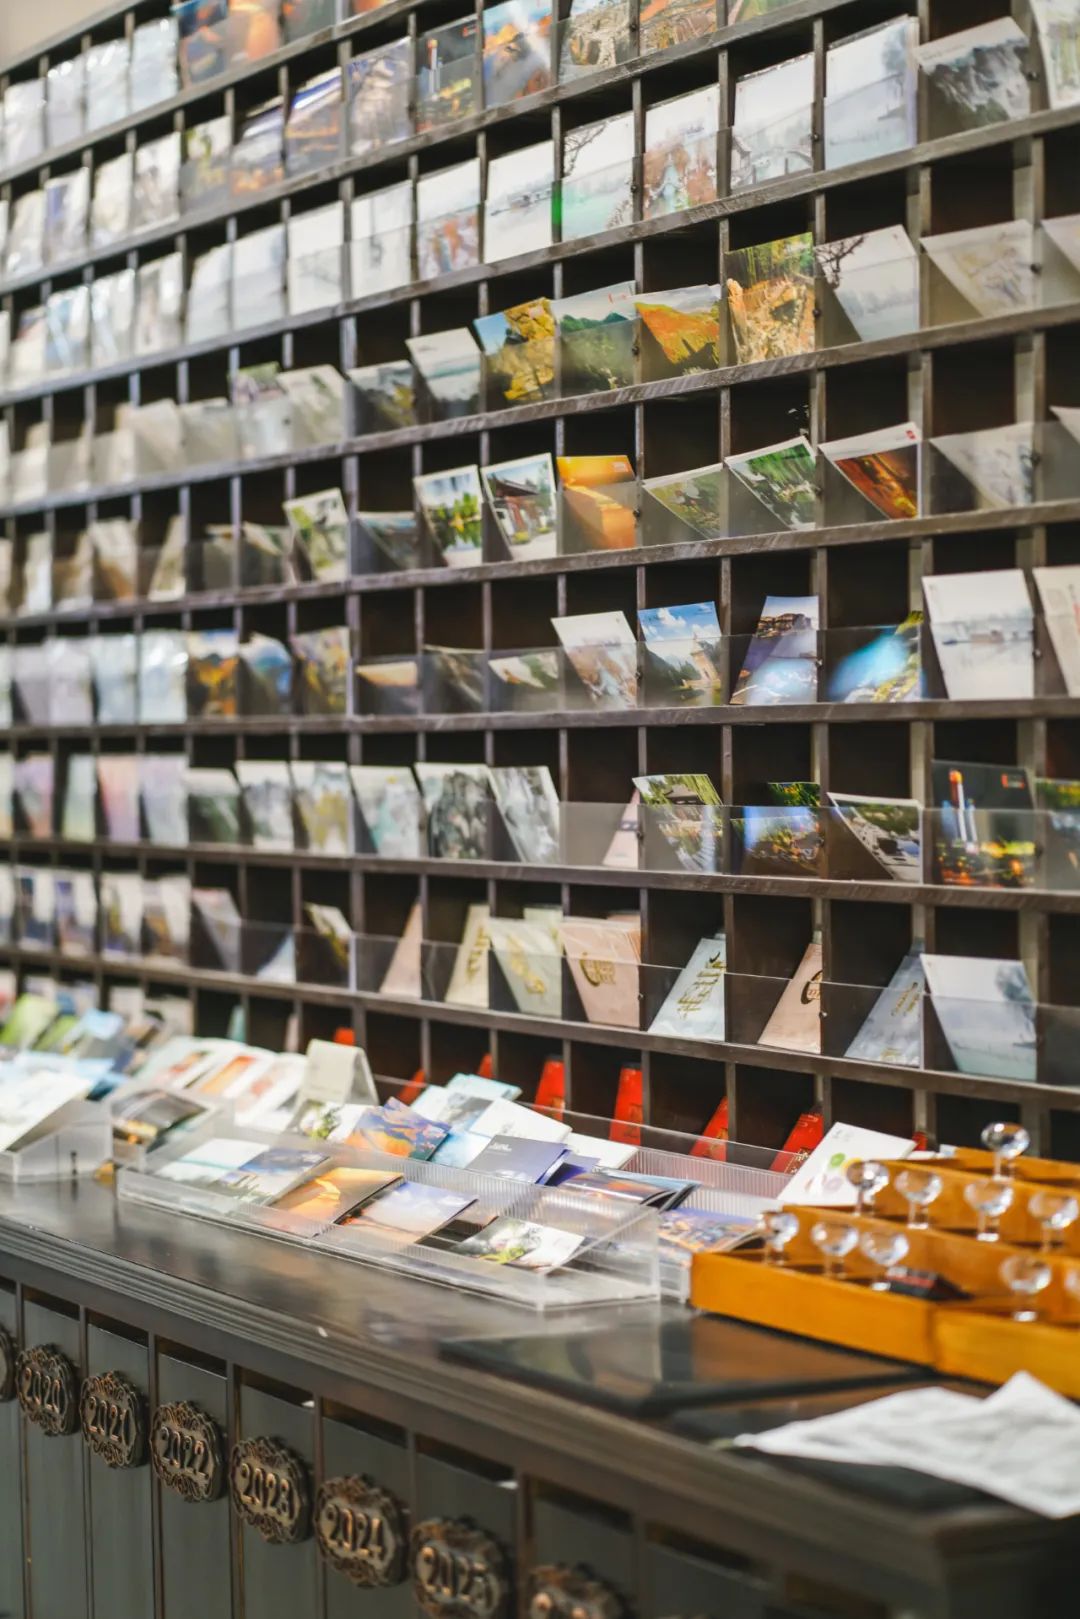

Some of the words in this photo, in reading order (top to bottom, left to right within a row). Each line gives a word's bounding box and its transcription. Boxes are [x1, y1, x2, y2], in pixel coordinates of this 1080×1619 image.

[87, 1396, 126, 1444] 2021
[160, 1427, 208, 1478] 2022
[241, 1463, 290, 1519] 2023
[323, 1504, 384, 1560] 2024
